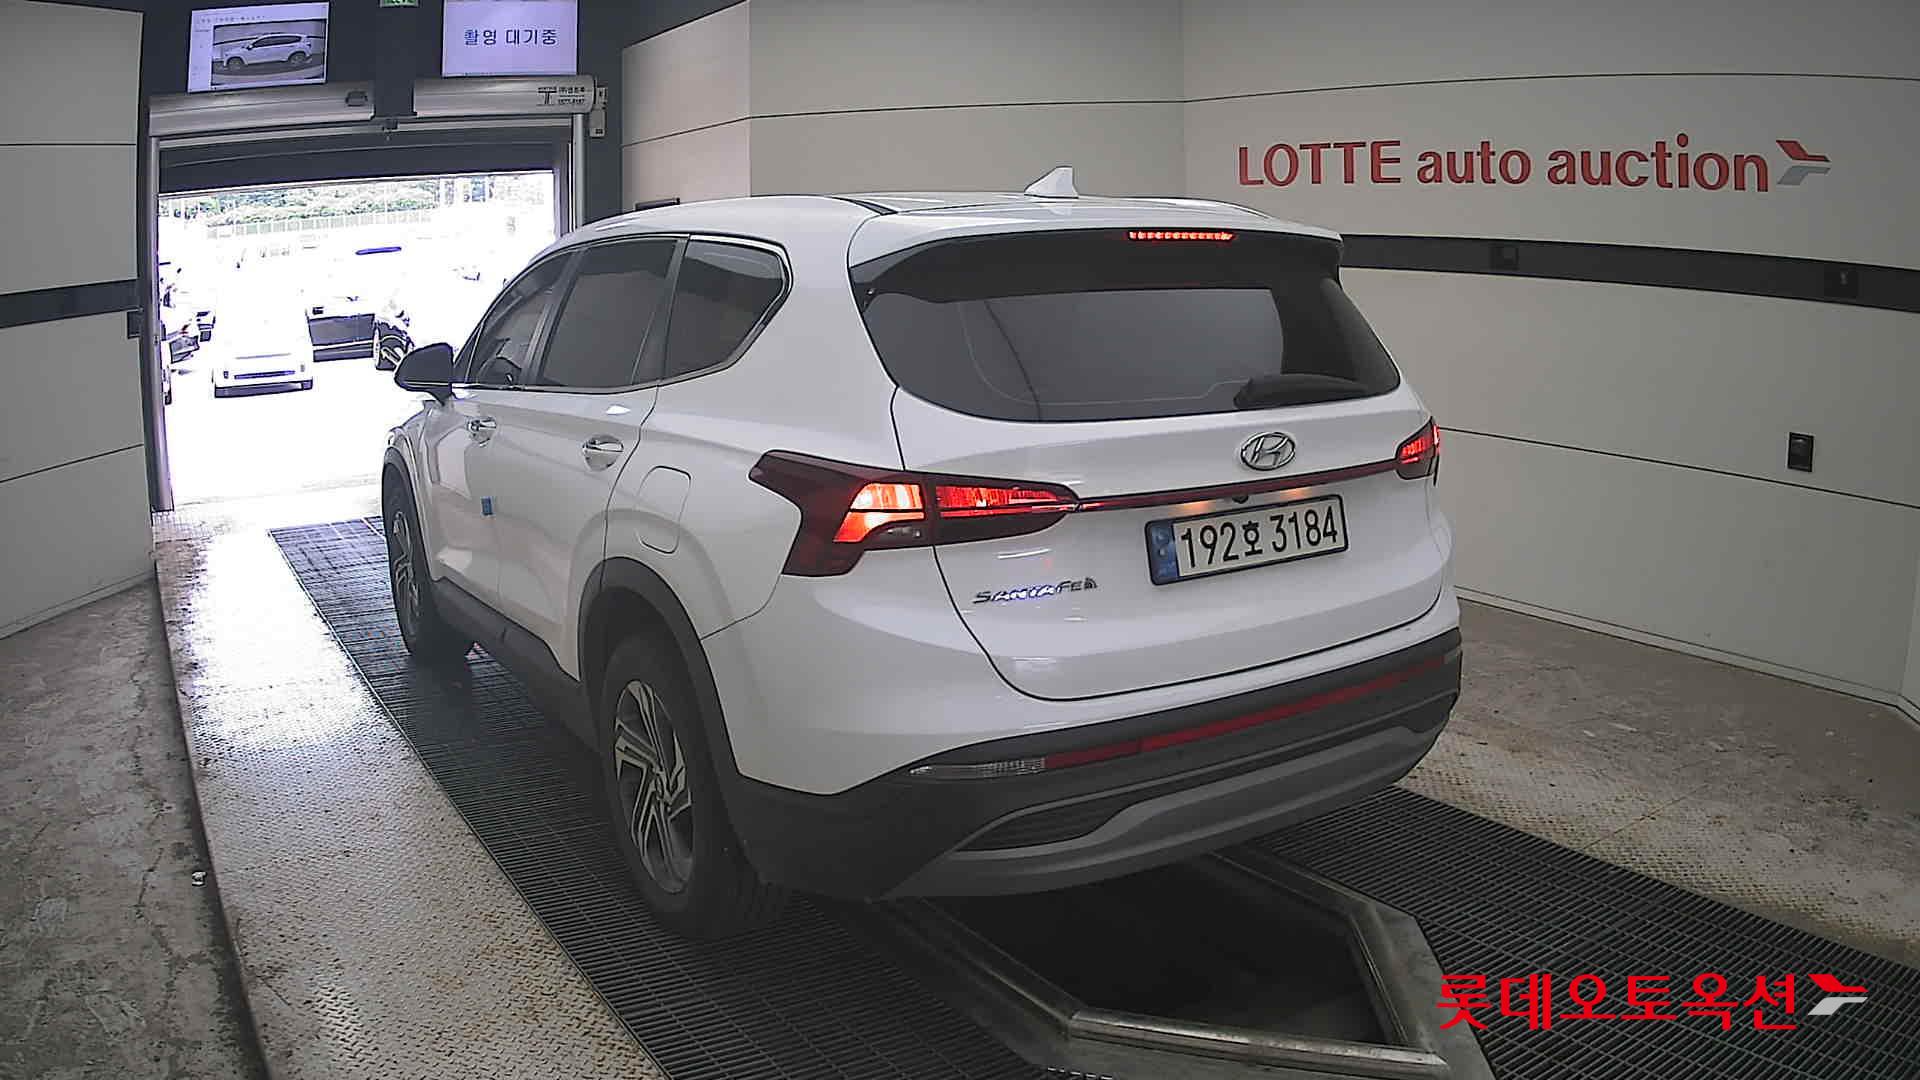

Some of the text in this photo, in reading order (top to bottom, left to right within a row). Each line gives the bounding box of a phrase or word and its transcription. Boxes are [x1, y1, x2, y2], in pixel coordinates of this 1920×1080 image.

[464, 27, 559, 47] 촬영 대기중
[1238, 132, 1769, 193] LOTTE auto auction
[1181, 520, 1263, 568] 192호
[1270, 505, 1338, 552] 3184
